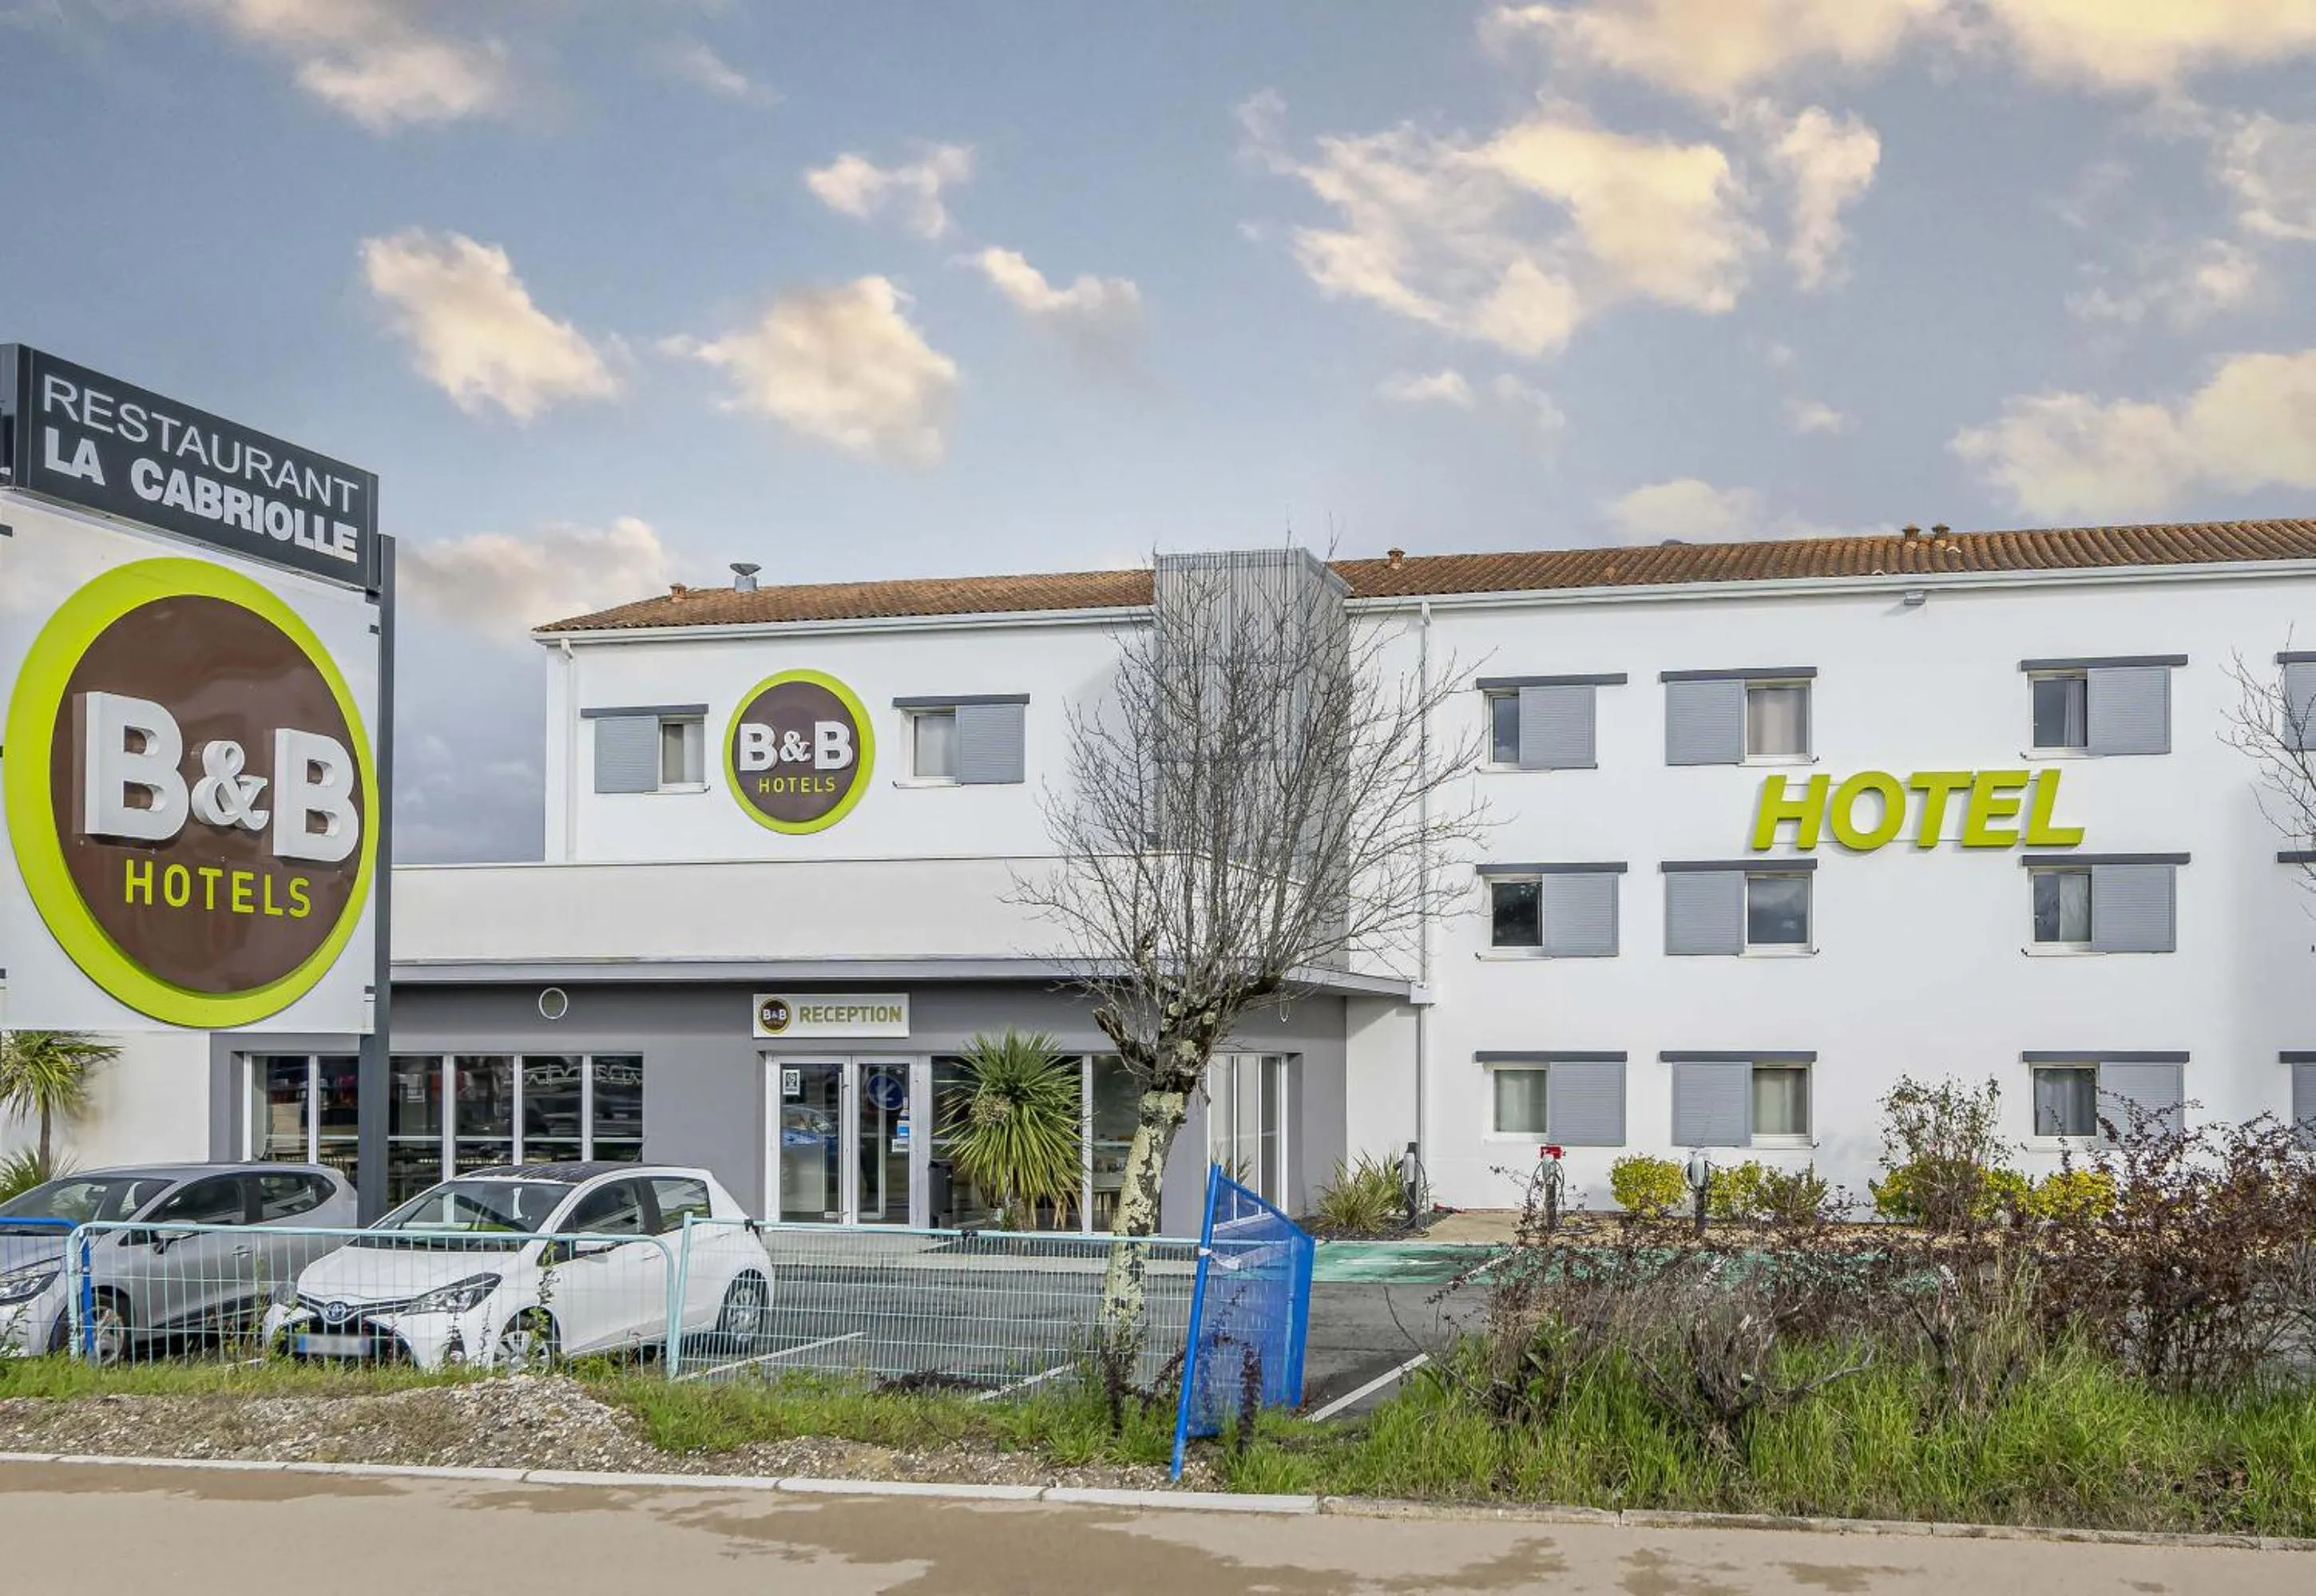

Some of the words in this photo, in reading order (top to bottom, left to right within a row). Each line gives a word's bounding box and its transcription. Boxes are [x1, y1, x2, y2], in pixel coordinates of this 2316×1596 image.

[43, 373, 359, 513] RESTAURANT
[44, 426, 106, 486] LA
[130, 457, 359, 564] CABRIOLLE
[83, 691, 359, 862] B&B
[739, 720, 853, 771] B&B
[758, 776, 836, 793] HOTELS
[1751, 767, 2086, 851] HOTEL
[125, 858, 311, 918] HOTELS
[799, 1005, 902, 1023] RECEPTION
